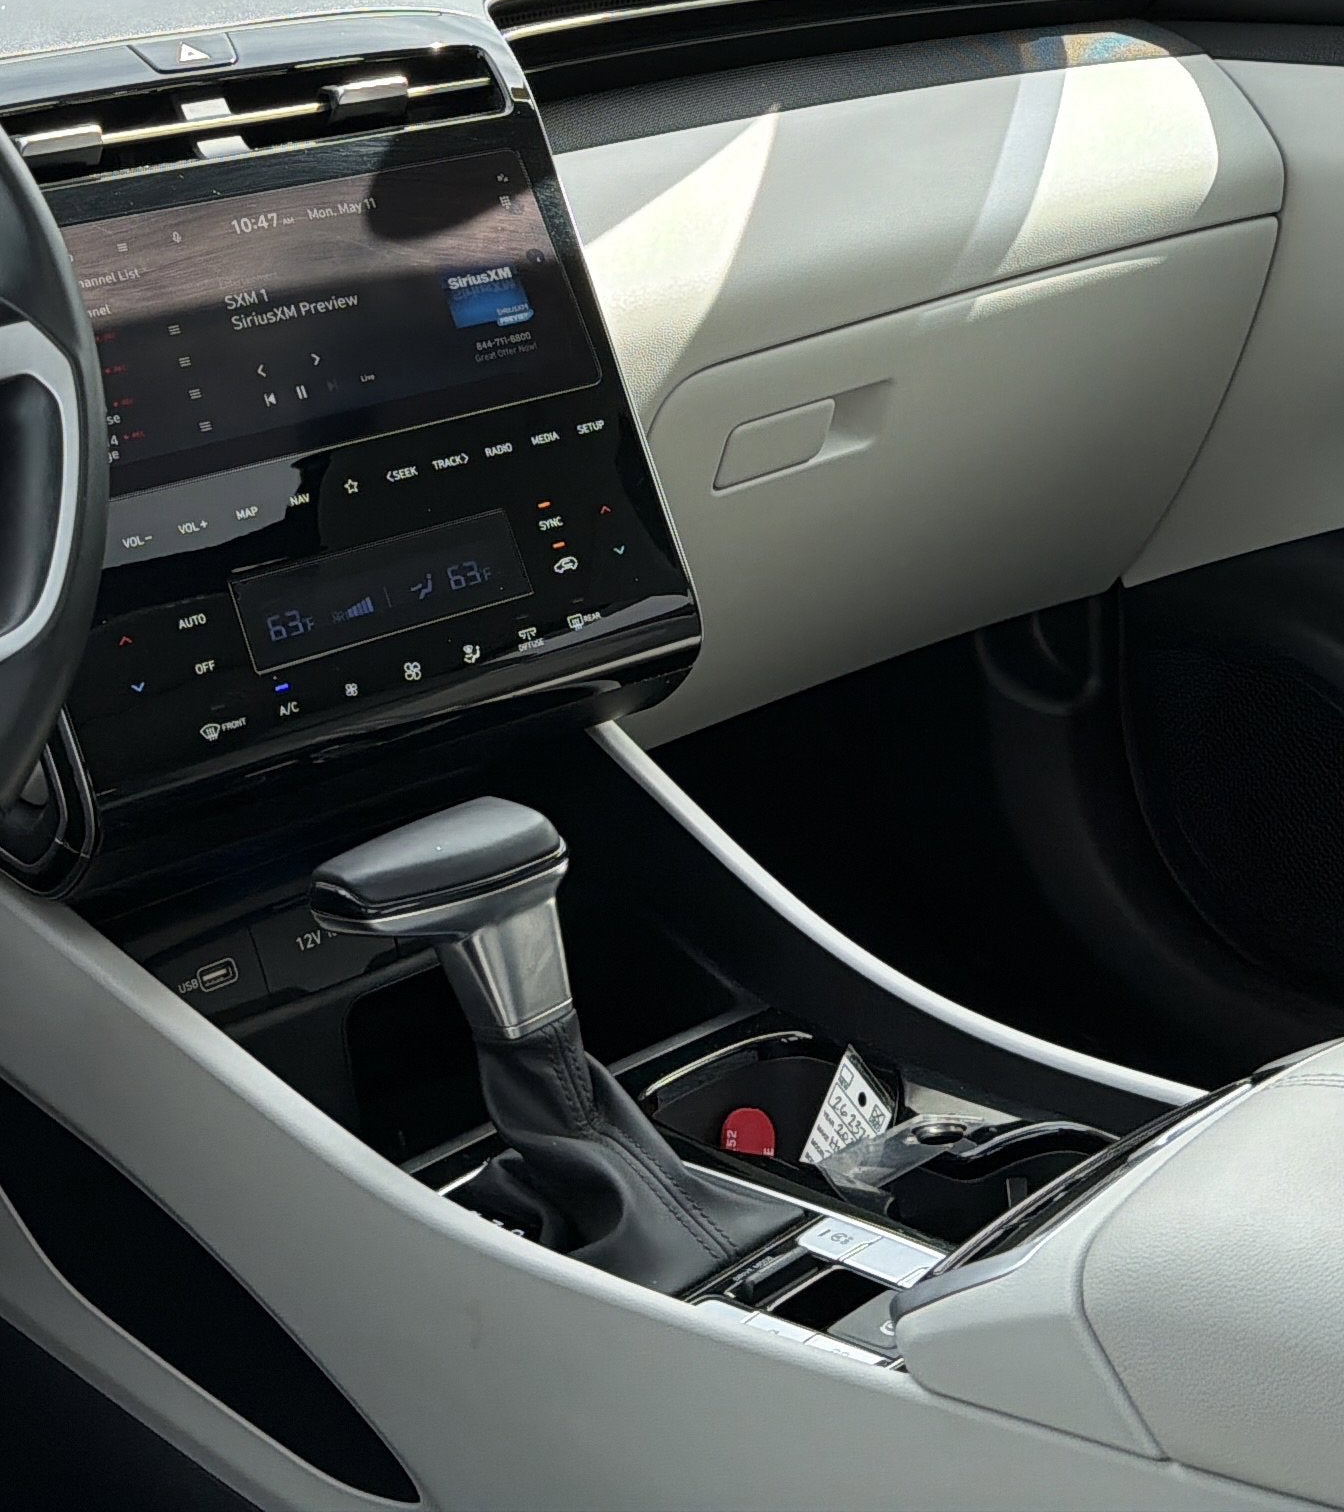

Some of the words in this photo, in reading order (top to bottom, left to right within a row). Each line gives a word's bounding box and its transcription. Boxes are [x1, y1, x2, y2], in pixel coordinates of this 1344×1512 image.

[231, 212, 278, 235] 10:47
[282, 216, 295, 226] AM
[337, 200, 363, 216] May
[363, 197, 376, 210] 11
[118, 268, 141, 283] List
[447, 266, 513, 290] SiriusXM
[224, 291, 256, 310] SXM
[259, 289, 269, 303] 1
[230, 305, 298, 331] SiriusXM
[299, 294, 359, 317] Preview
[359, 374, 375, 383] Live
[577, 419, 606, 436] SETUP
[530, 431, 560, 446] MEDIA
[485, 442, 513, 459] RADIO
[392, 465, 418, 482] SEEK
[432, 454, 463, 472] TRACK
[289, 492, 311, 507] NAV
[235, 504, 259, 521] MAP
[538, 516, 564, 532] SYNC
[177, 613, 207, 630] AUTO
[582, 611, 602, 623] REAR
[194, 660, 216, 676] OFF
[278, 700, 300, 717] A/C
[222, 717, 247, 732] FRONT
[296, 929, 321, 952] 12V
[177, 978, 199, 995] USB
